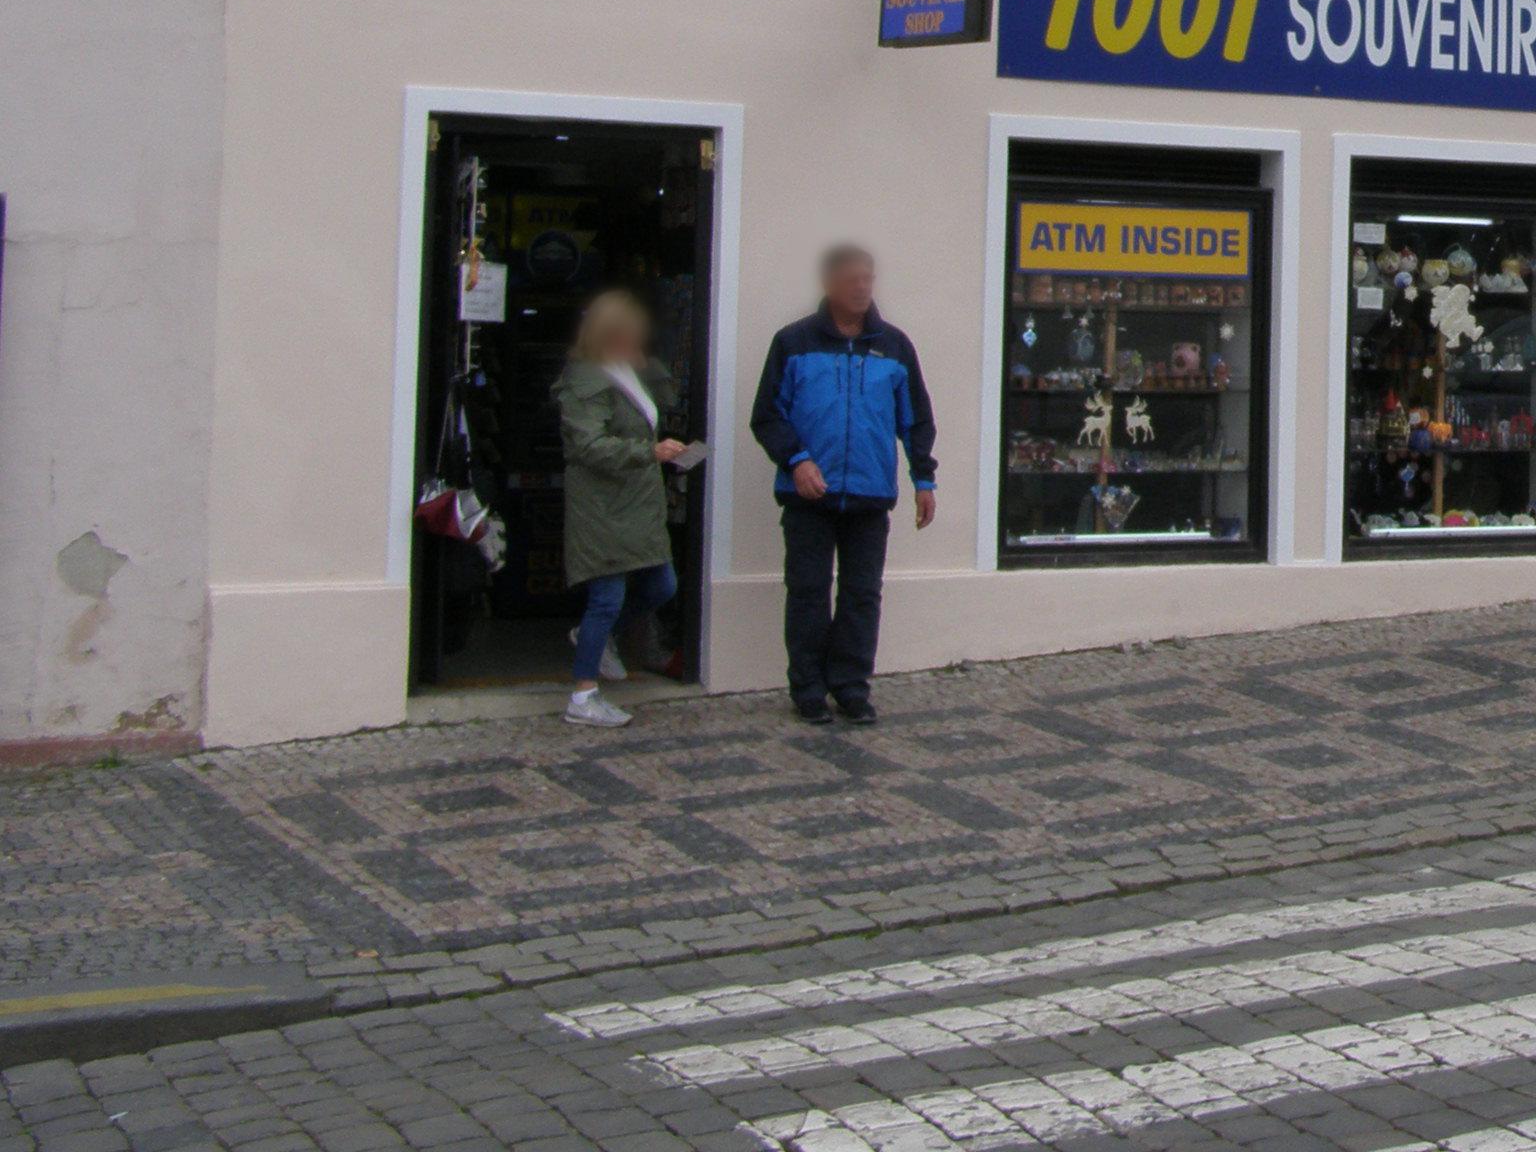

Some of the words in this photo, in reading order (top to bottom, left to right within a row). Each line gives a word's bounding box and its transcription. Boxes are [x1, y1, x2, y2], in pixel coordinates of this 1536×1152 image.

[904, 11, 944, 35] SHOP
[1030, 221, 1106, 253] ATM
[1120, 225, 1240, 257] INSIDE
